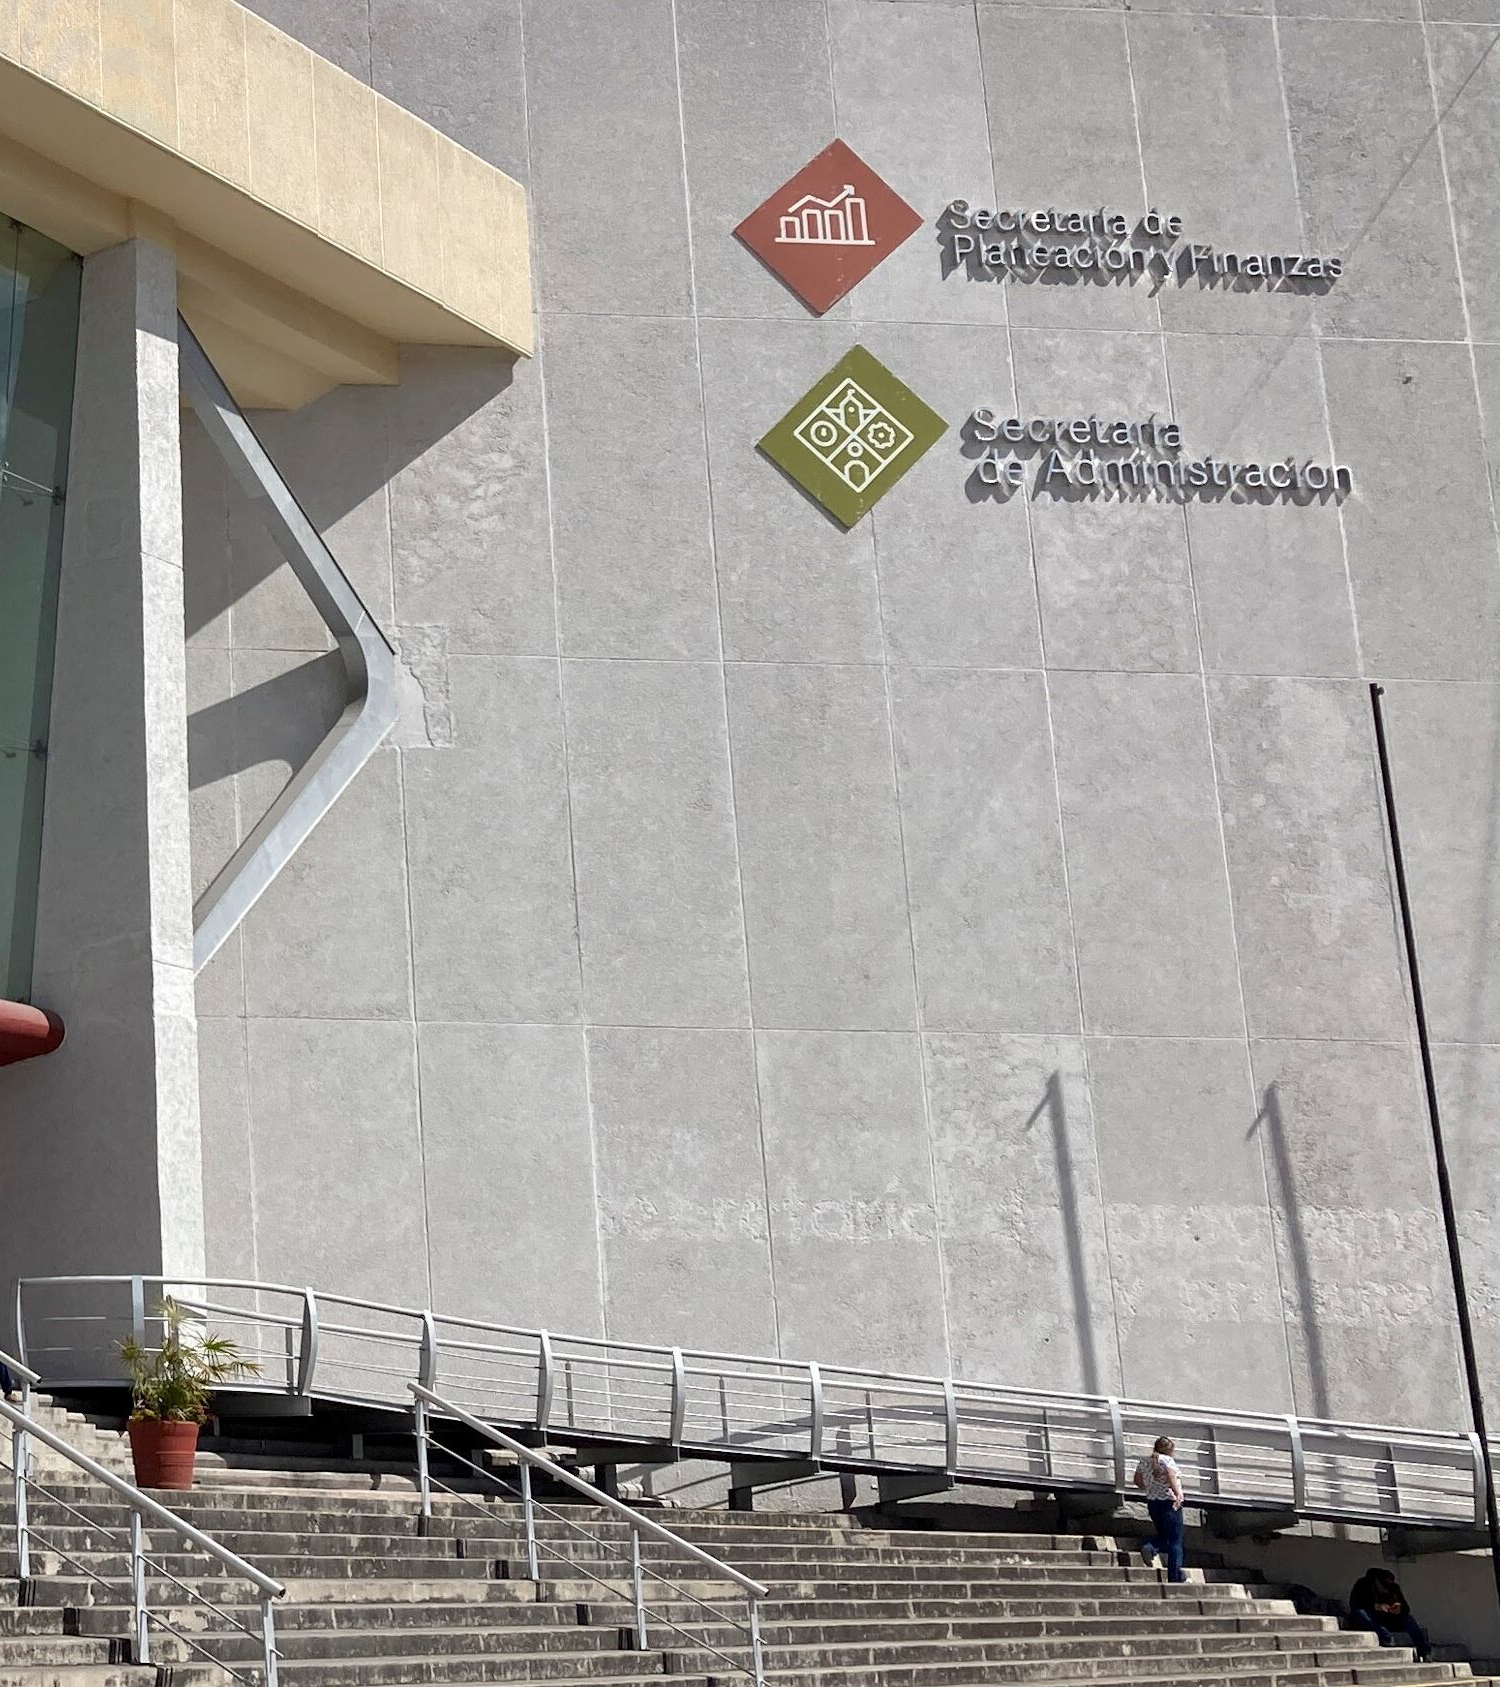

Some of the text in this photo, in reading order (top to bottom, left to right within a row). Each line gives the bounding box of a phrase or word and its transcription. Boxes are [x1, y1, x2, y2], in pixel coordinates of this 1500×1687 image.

[1143, 207, 1184, 236] de
[1150, 245, 1177, 279] y
[1189, 243, 1343, 278] Finanzas
[979, 447, 1026, 486] de
